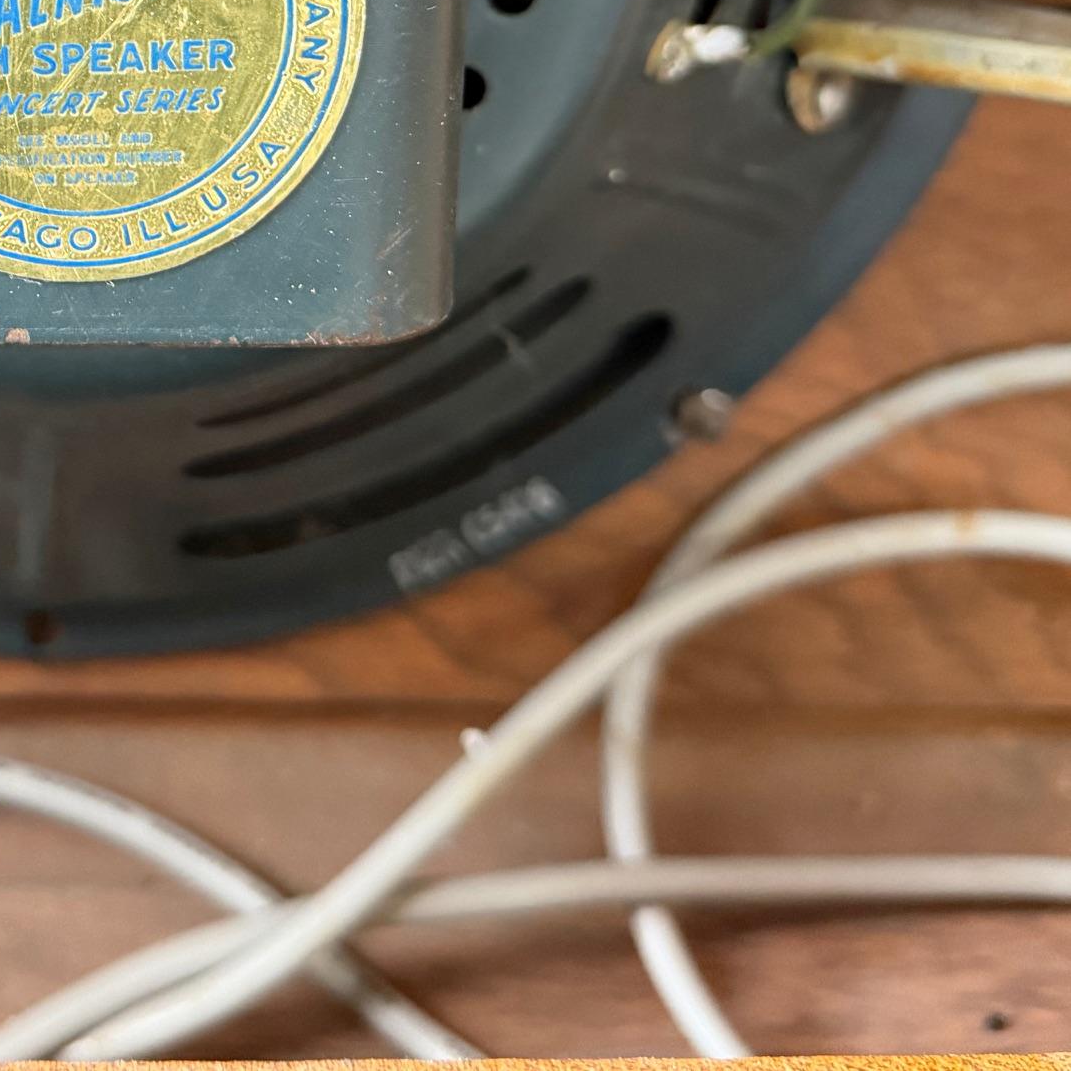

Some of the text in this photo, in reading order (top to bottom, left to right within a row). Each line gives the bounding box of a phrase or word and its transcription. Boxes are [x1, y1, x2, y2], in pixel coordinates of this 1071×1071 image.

[32, 39, 236, 76] SPEAKER
[115, 86, 224, 114] SERIES
[119, 131, 153, 145] AND
